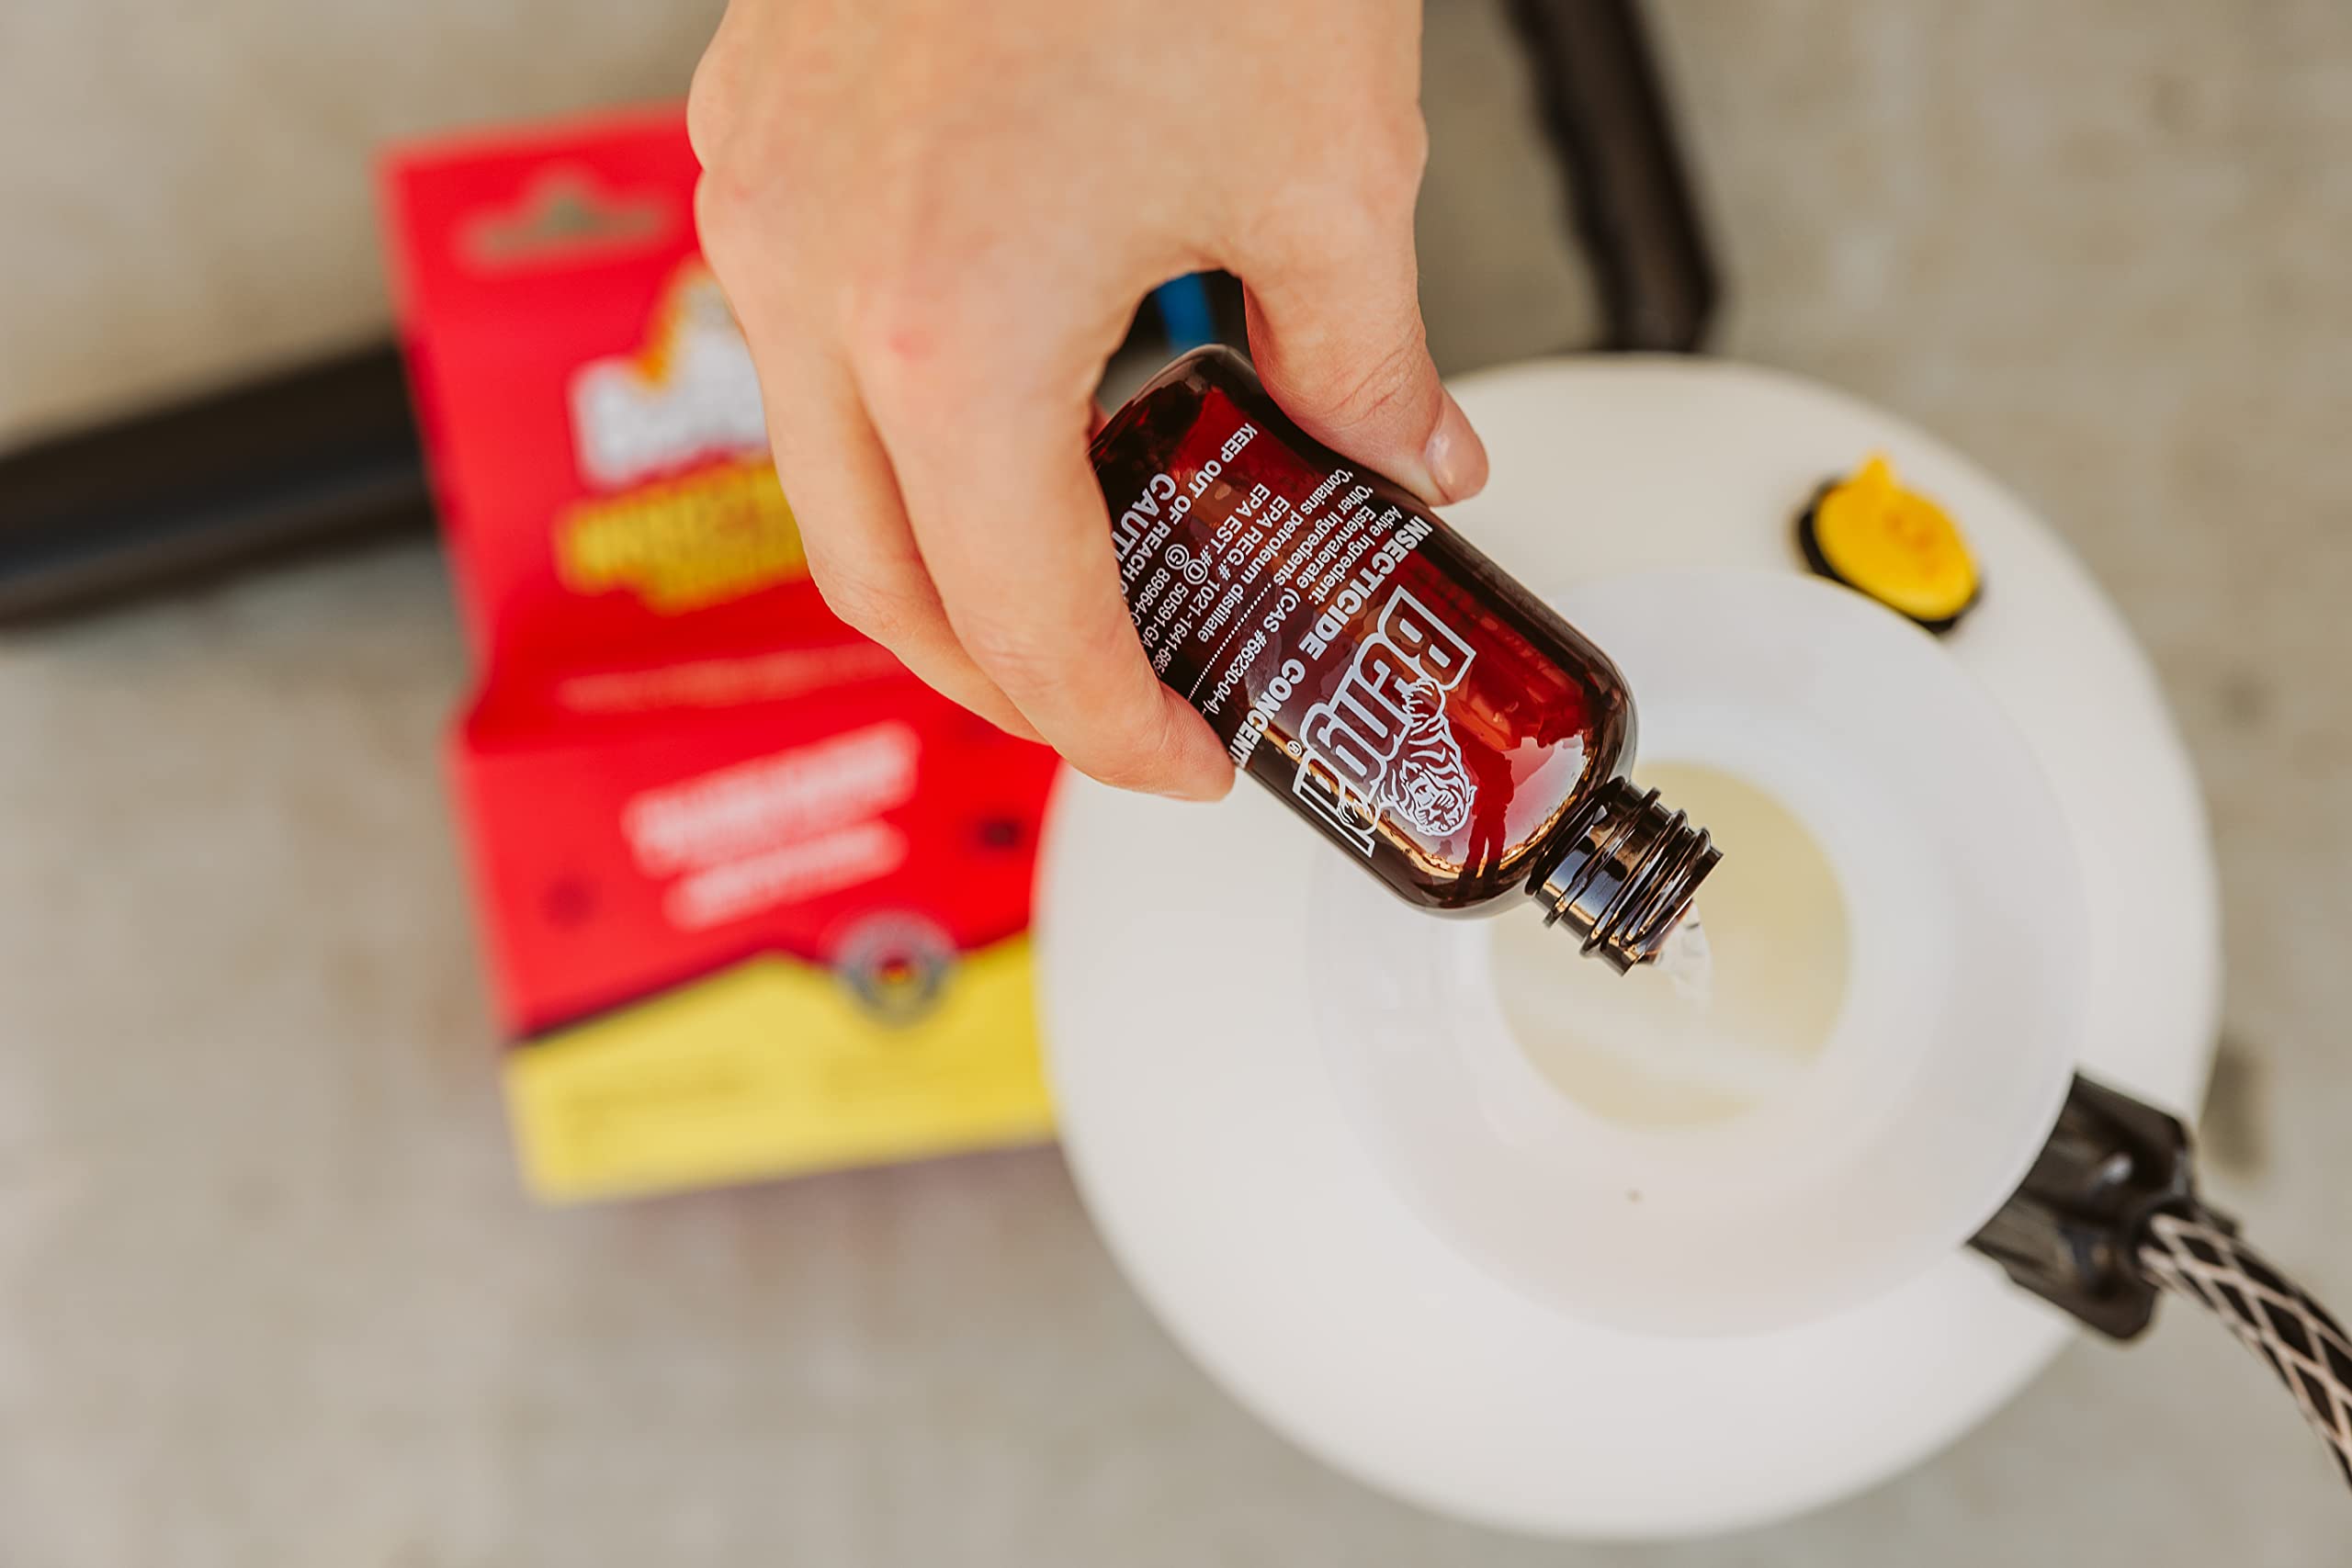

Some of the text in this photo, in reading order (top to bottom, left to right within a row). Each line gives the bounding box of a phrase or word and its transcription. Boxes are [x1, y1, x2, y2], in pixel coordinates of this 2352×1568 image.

[1221, 423, 1257, 462] KEEP
[1189, 460, 1221, 498] OUT
[1236, 483, 1271, 516] EPA
[1170, 496, 1191, 525] OF
[1256, 495, 1290, 527] EPA
[1123, 521, 1170, 581] REACH
[1218, 526, 1263, 581] REG.#
[1241, 510, 1304, 583] petroleum
[1273, 512, 1343, 585] Ingredients
[1297, 503, 1376, 588] Esfenvalerate
[1308, 506, 1402, 604] Active Ingredient:
[1198, 583, 1243, 642] distillate
[1263, 588, 1300, 632] (CAS
[1299, 516, 1432, 660] INSECTICIDE
